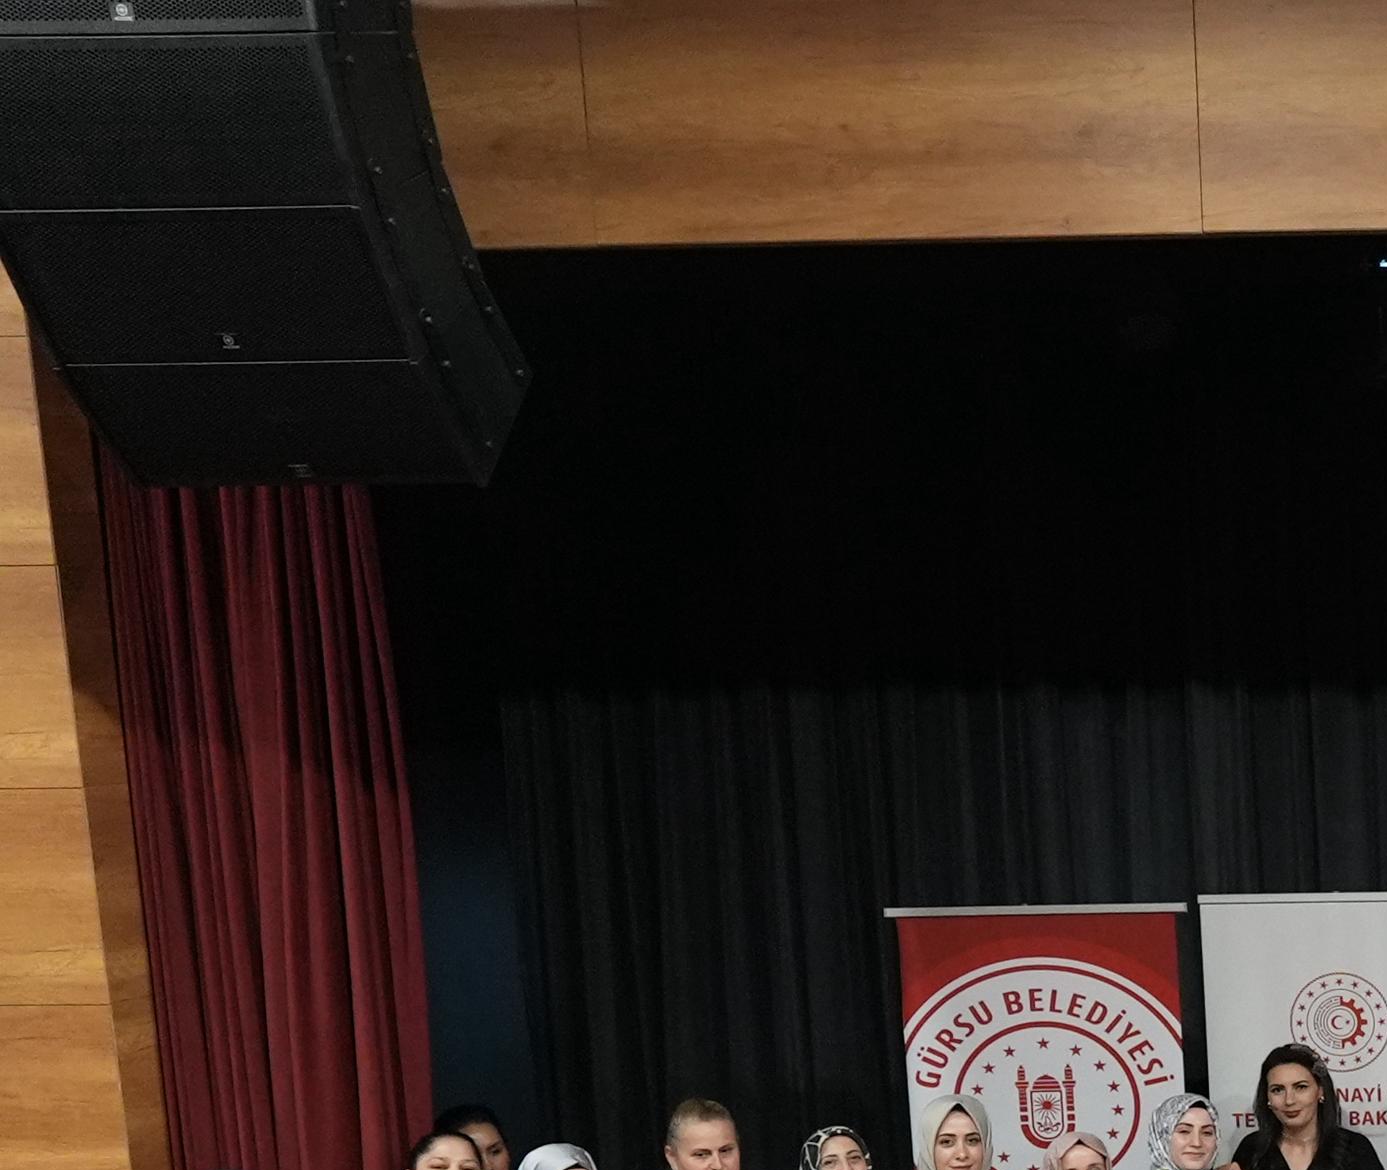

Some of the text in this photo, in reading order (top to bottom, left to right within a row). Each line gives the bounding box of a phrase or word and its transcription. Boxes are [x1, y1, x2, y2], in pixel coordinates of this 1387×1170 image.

[915, 988, 1175, 1088] GÜRSU BELEDİYESİ
[1336, 1084, 1381, 1102] NAYİ
